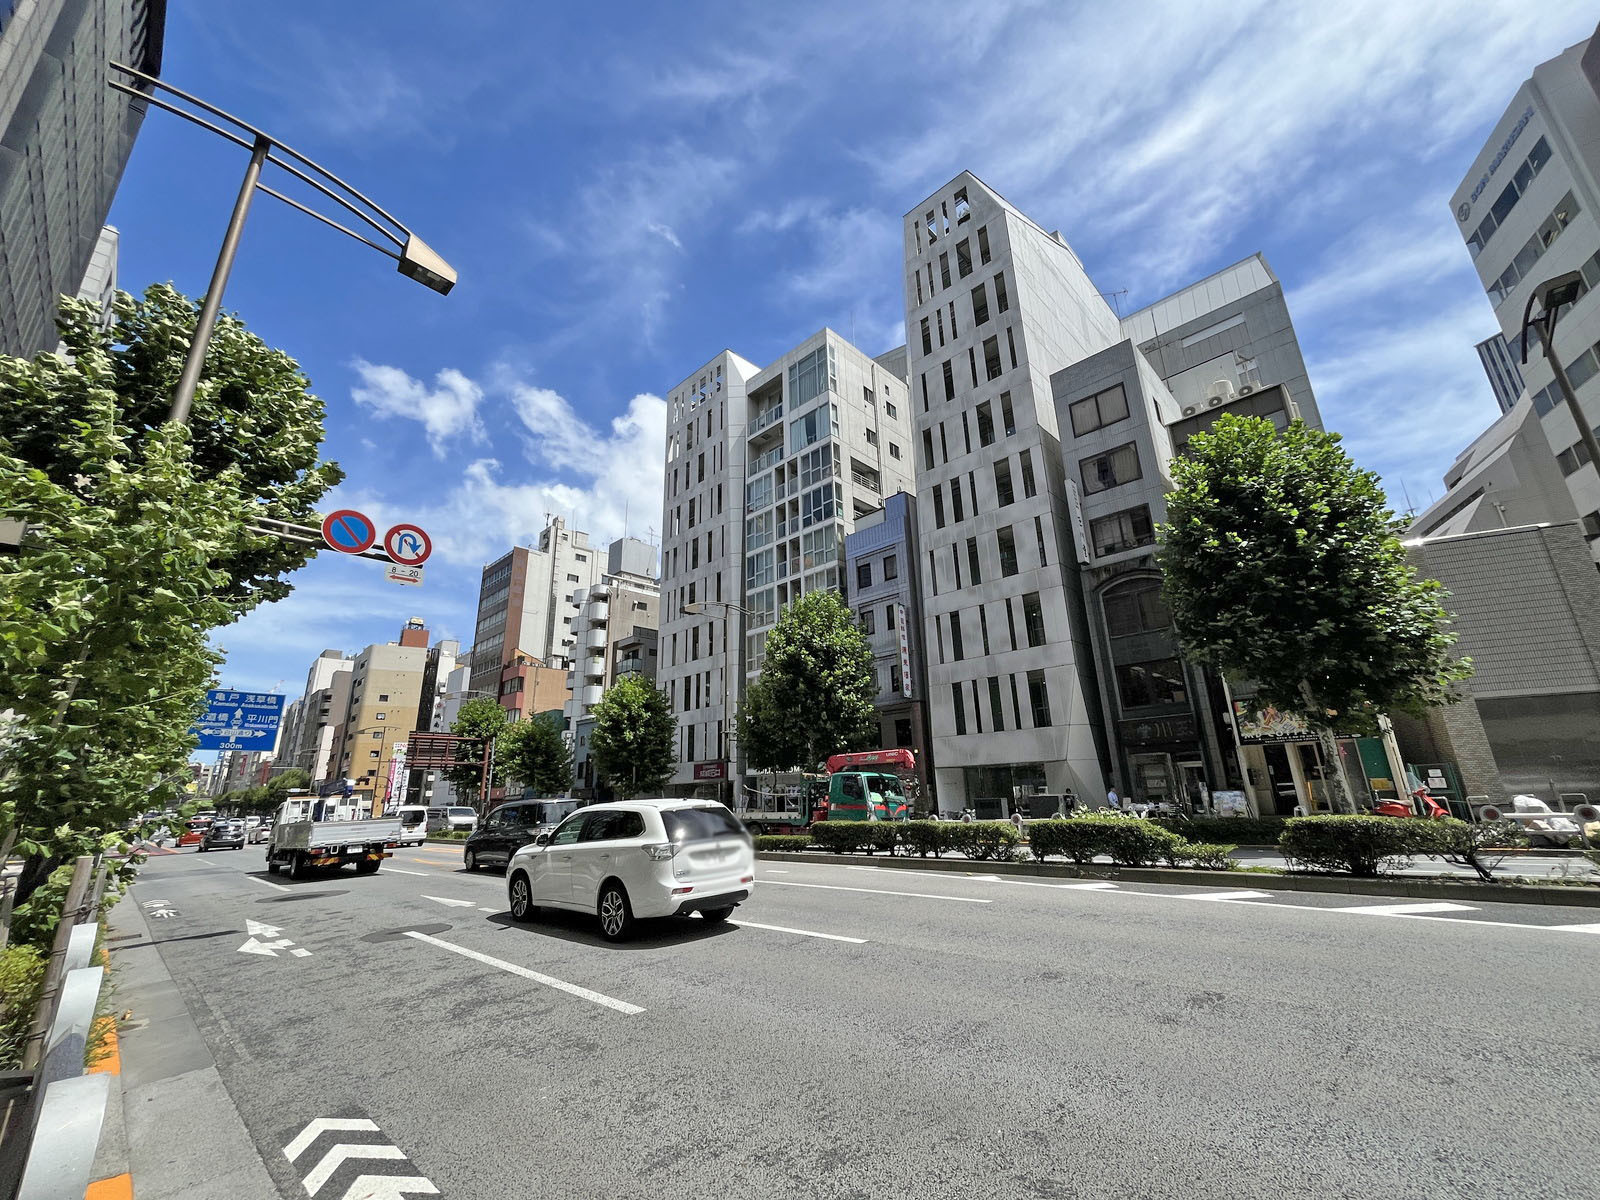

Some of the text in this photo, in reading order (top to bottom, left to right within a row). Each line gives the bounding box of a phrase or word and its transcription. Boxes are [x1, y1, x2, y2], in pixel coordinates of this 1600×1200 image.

[215, 692, 240, 701] 亀戸
[245, 694, 277, 704] 浅草橋
[248, 714, 278, 724] 平川門
